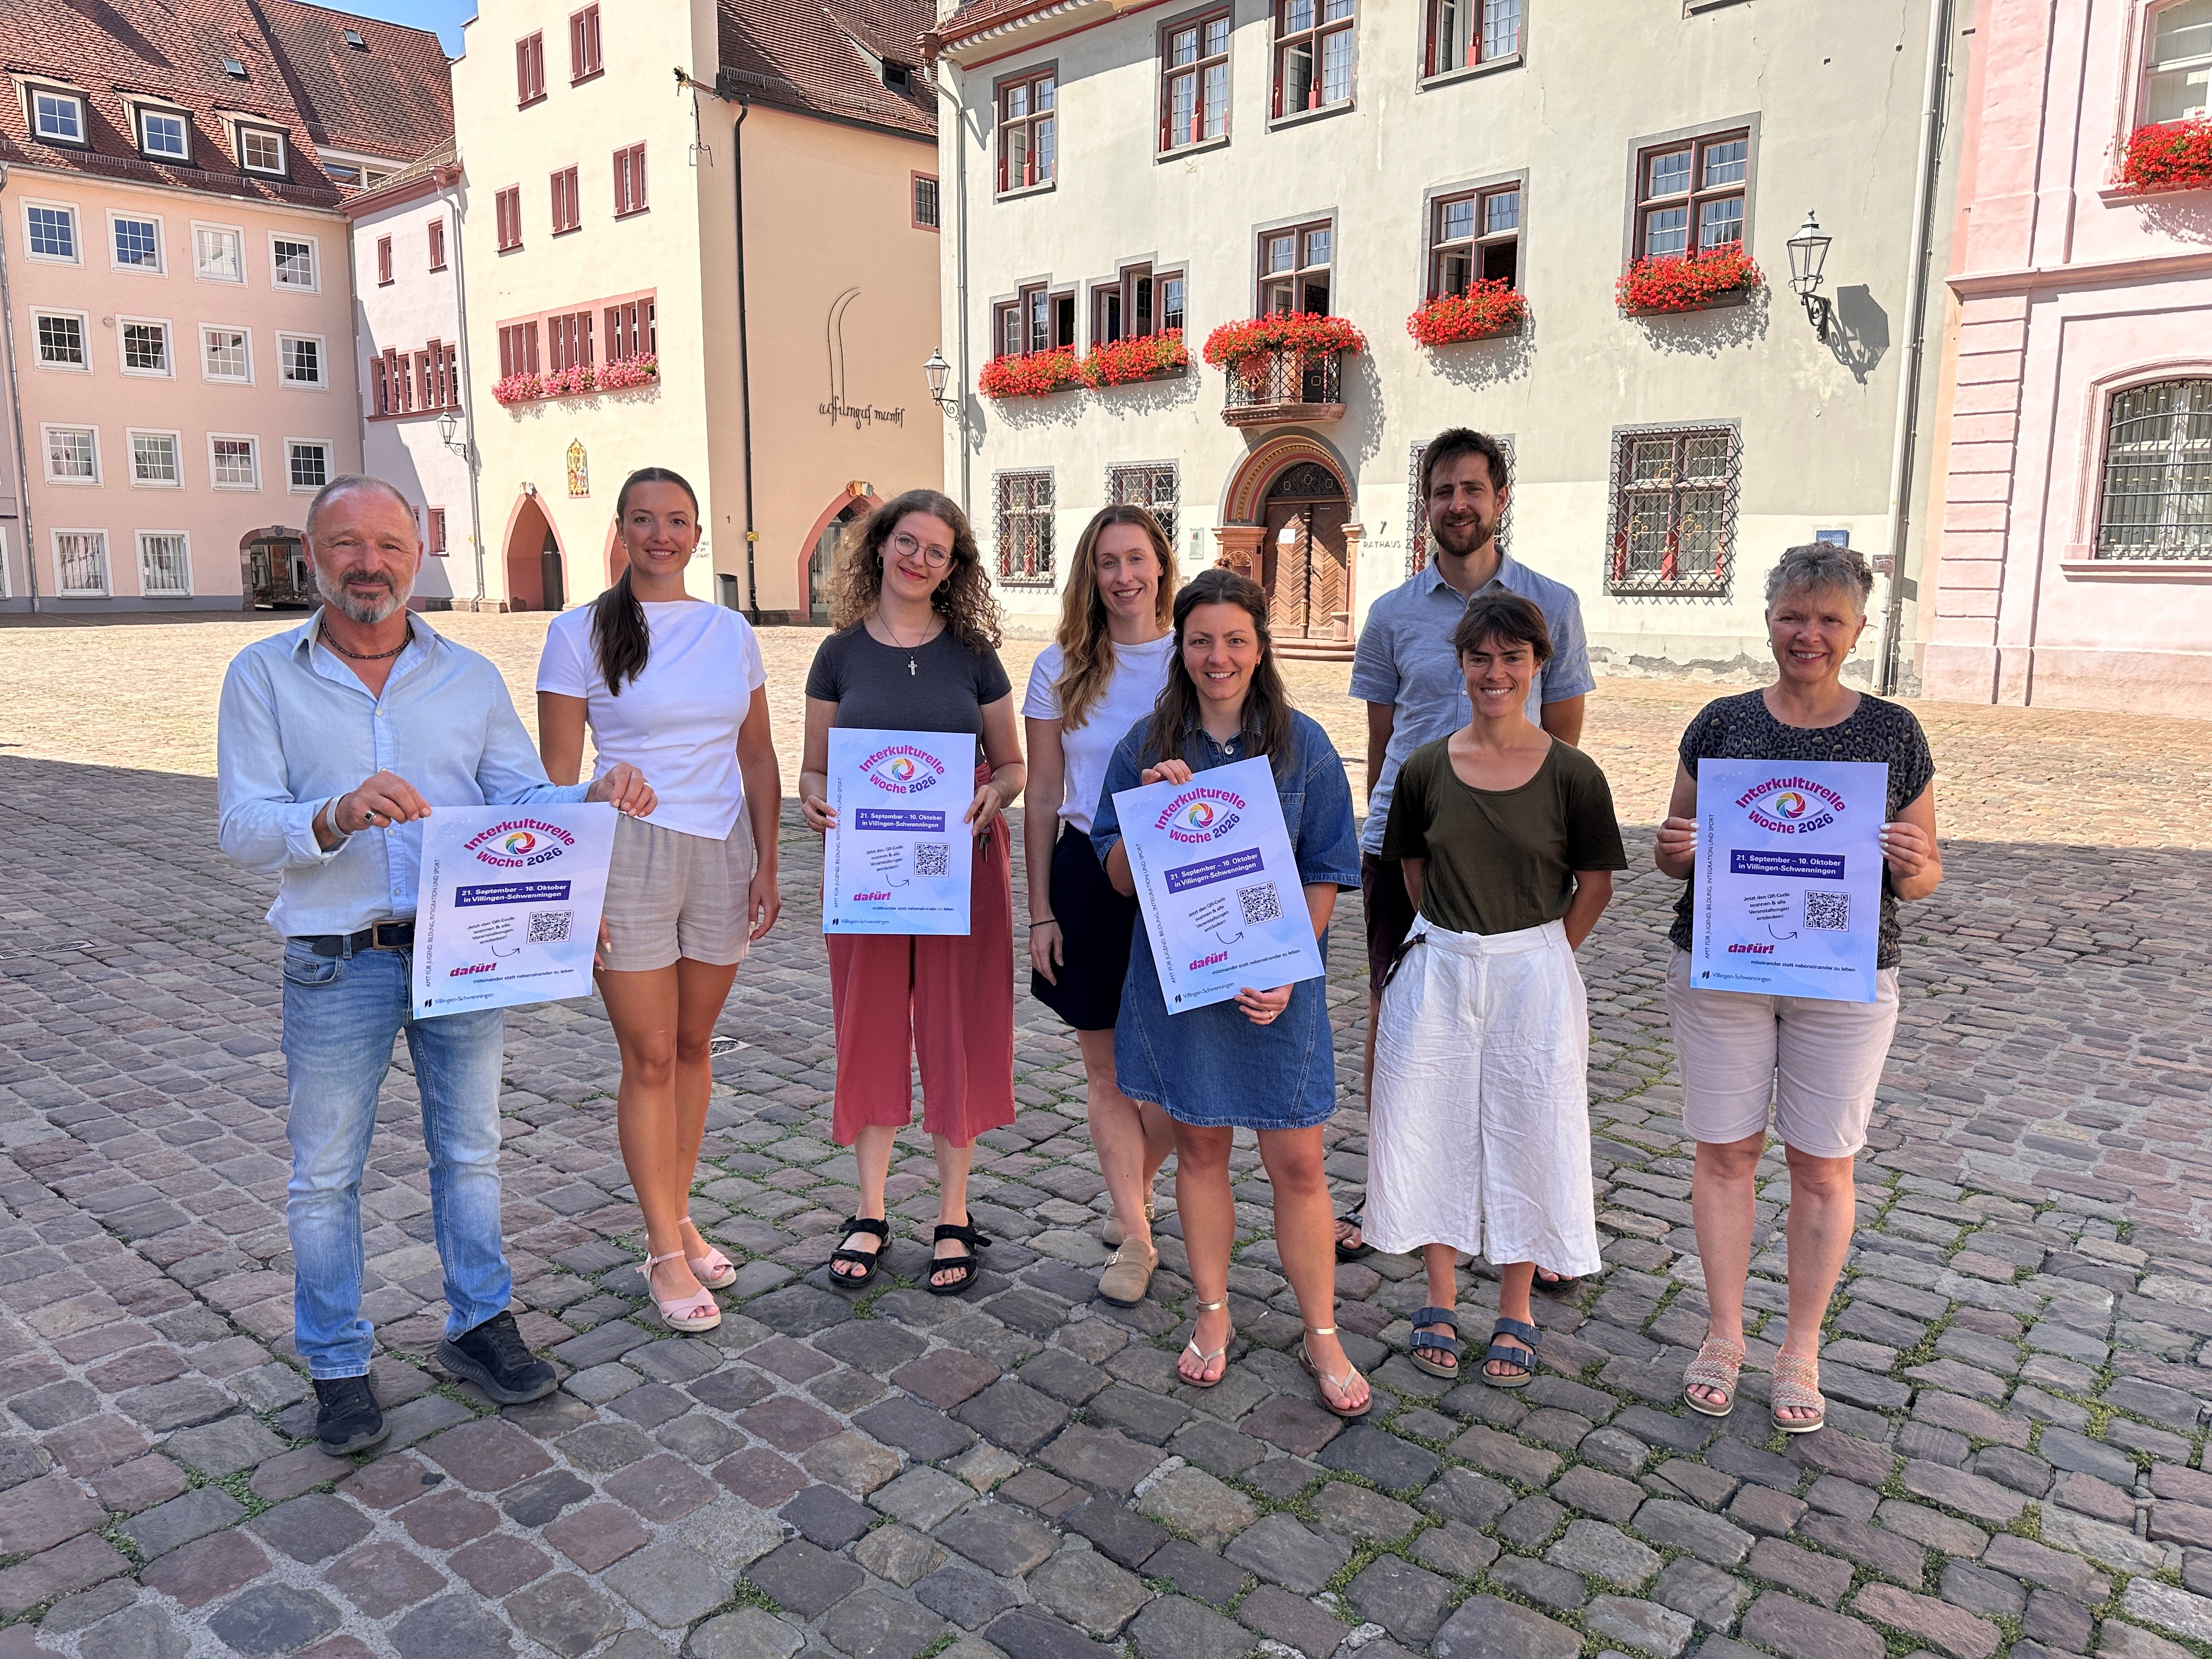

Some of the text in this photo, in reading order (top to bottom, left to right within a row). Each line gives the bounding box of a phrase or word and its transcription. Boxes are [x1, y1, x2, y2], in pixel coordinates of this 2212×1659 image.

[726, 516, 731, 524] 1
[1381, 521, 1387, 534] 7
[1363, 540, 1401, 549] RATHAUS
[859, 744, 944, 774] Interkulturelle
[870, 774, 935, 793] Woche 2026
[1735, 777, 1845, 811] Interkulturelle
[1154, 788, 1245, 830] Interkulturelle
[1170, 813, 1239, 843] Woche 2026
[1748, 810, 1833, 833] Woche 2026
[463, 819, 574, 850] Interkulturelle
[476, 848, 562, 867] Woche 2026
[1136, 843, 1144, 860] SPORT
[1181, 865, 1216, 877] September
[1232, 854, 1258, 864] Oktober
[1746, 864, 1836, 874] Villingen-Schwenningen
[1181, 863, 1256, 885] Villingen-Schwenningen
[472, 893, 561, 901] Villingen-Schwenningen
[853, 891, 891, 901] dafür!
[1144, 874, 1157, 910] INTEGRATION
[1207, 897, 1224, 907] QR-Code
[1195, 911, 1212, 921] scannen
[1195, 911, 1229, 928] Veranstaltungen
[1204, 919, 1226, 932] entdecken!
[472, 929, 513, 939] Veranstaltungen
[479, 935, 507, 944] entdecken!
[1728, 943, 1774, 953] dafür!
[1189, 951, 1228, 970] dafür!
[1212, 964, 1238, 974] miteinander
[1249, 953, 1281, 965] nebeneinander
[450, 962, 496, 977] dafür!
[1712, 972, 1771, 982] Villingen-Schwenningen
[435, 993, 494, 1003] Villingen-Schwenningen
[1183, 982, 1234, 998] Villingen-Schwenningen
